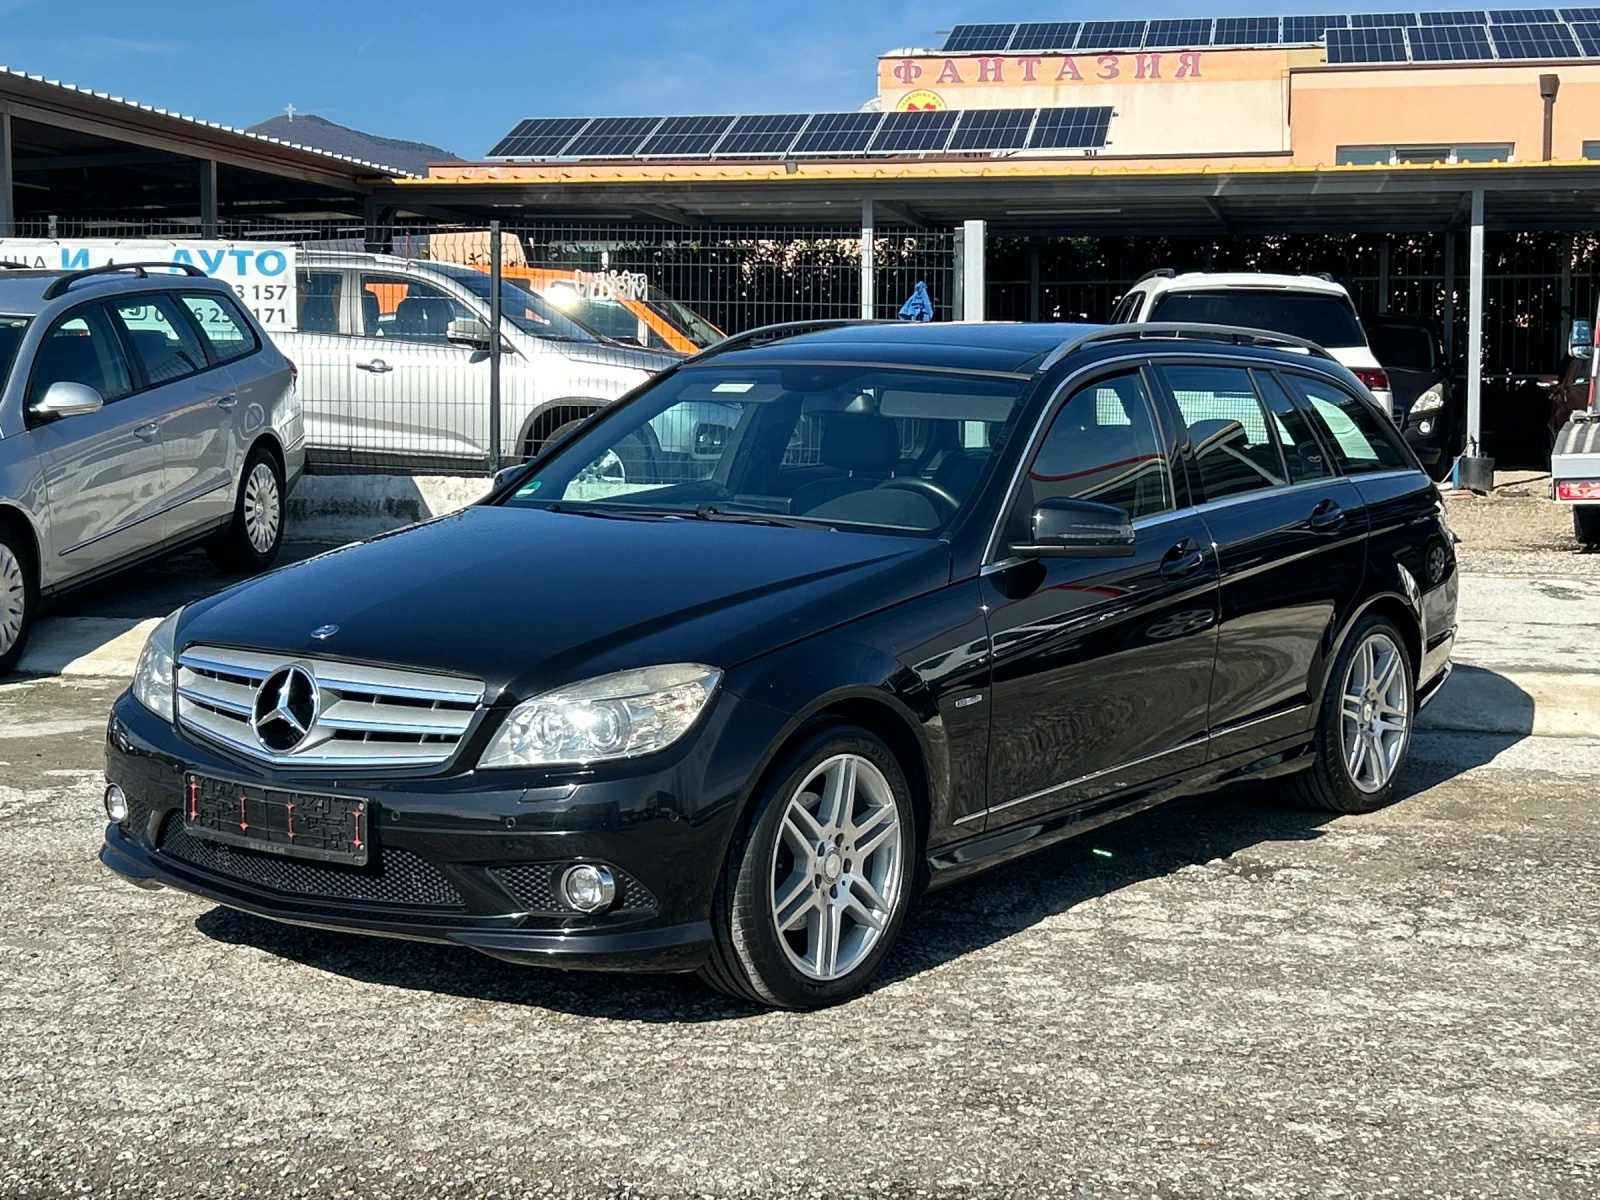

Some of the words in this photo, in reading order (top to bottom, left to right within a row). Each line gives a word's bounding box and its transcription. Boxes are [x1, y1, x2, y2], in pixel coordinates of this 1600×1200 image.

[893, 52, 1202, 84] ФАНТАЗИЯ
[170, 249, 287, 276] АУТО
[252, 284, 287, 300] 157
[252, 308, 285, 323] 171
